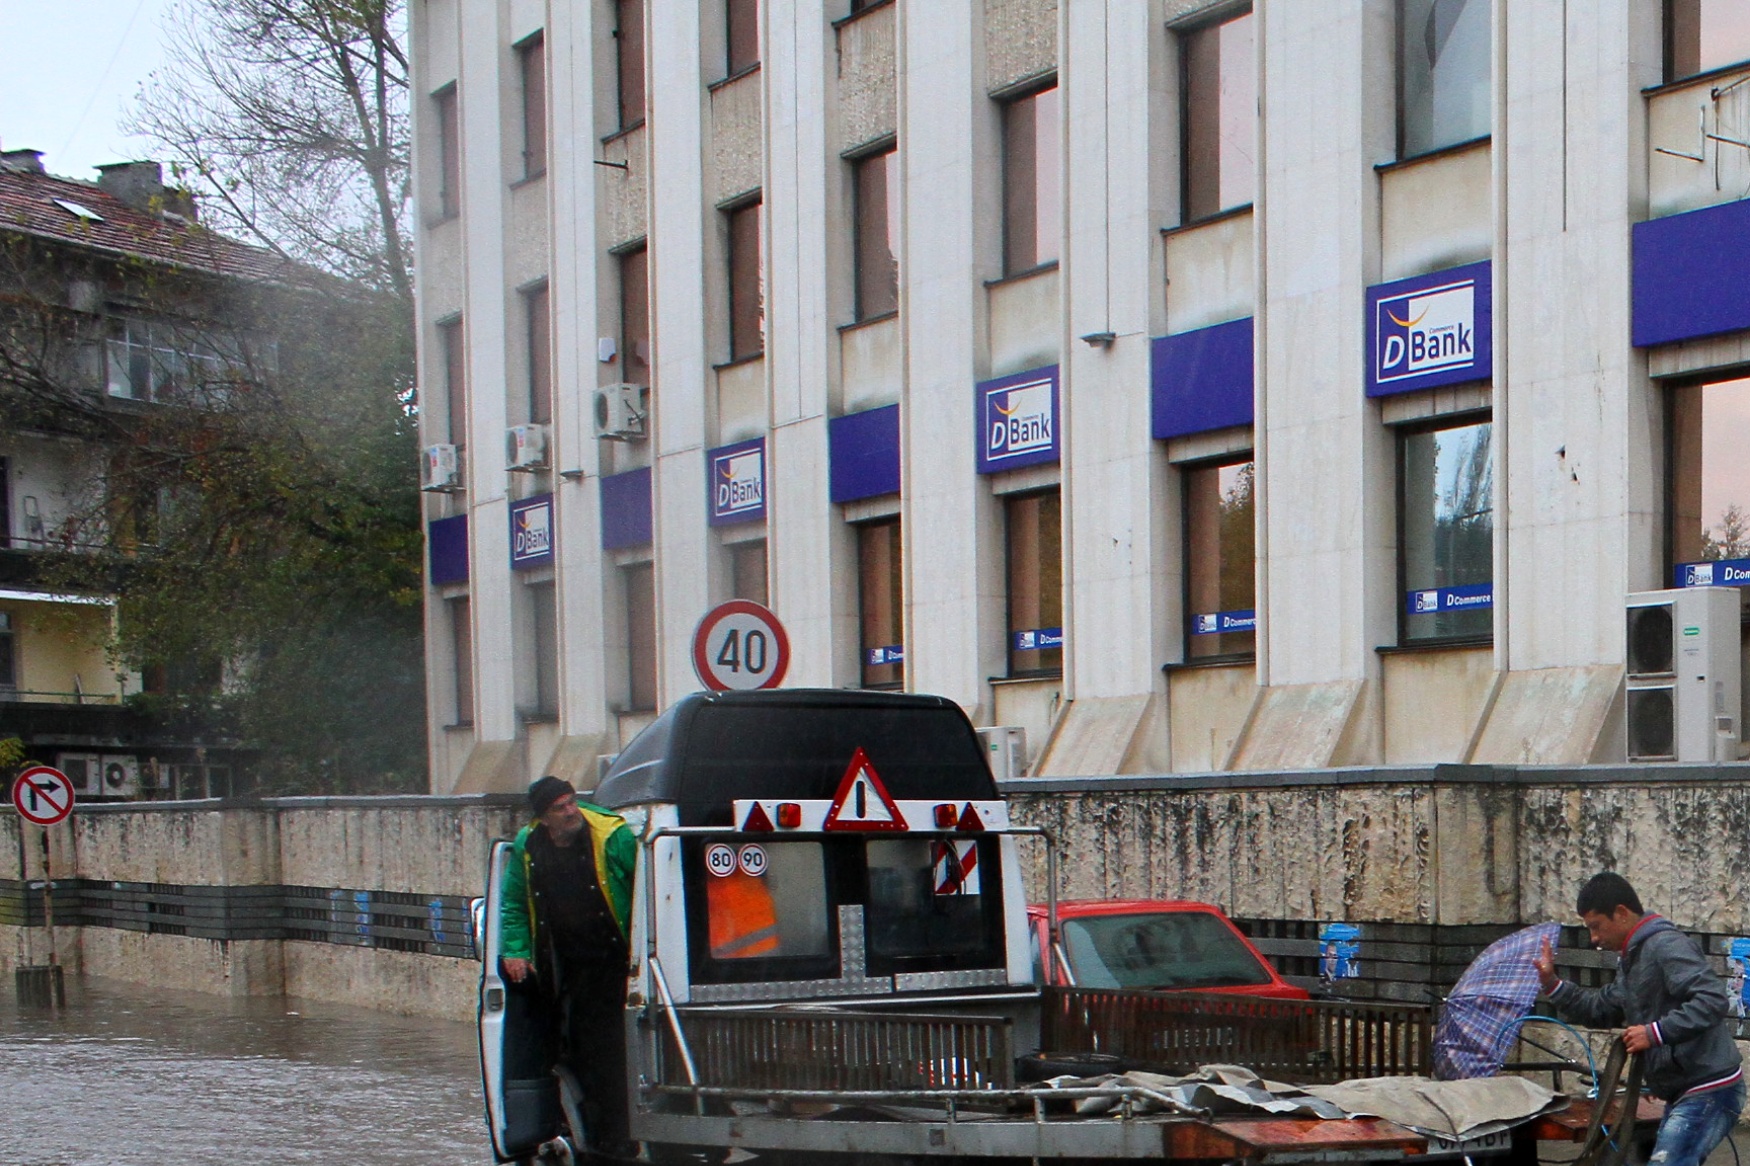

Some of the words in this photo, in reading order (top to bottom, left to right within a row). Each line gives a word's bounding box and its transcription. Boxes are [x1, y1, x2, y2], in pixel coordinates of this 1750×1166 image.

[1383, 335, 1406, 370] D
[1411, 322, 1472, 363] Bank
[1010, 412, 1050, 445] Bank
[732, 476, 761, 504] Bank
[1724, 567, 1734, 581] D
[1447, 593, 1454, 606] D
[1454, 594, 1491, 606] Commerce
[717, 629, 767, 674] 40
[712, 852, 731, 868] 80
[743, 852, 763, 867] 90
